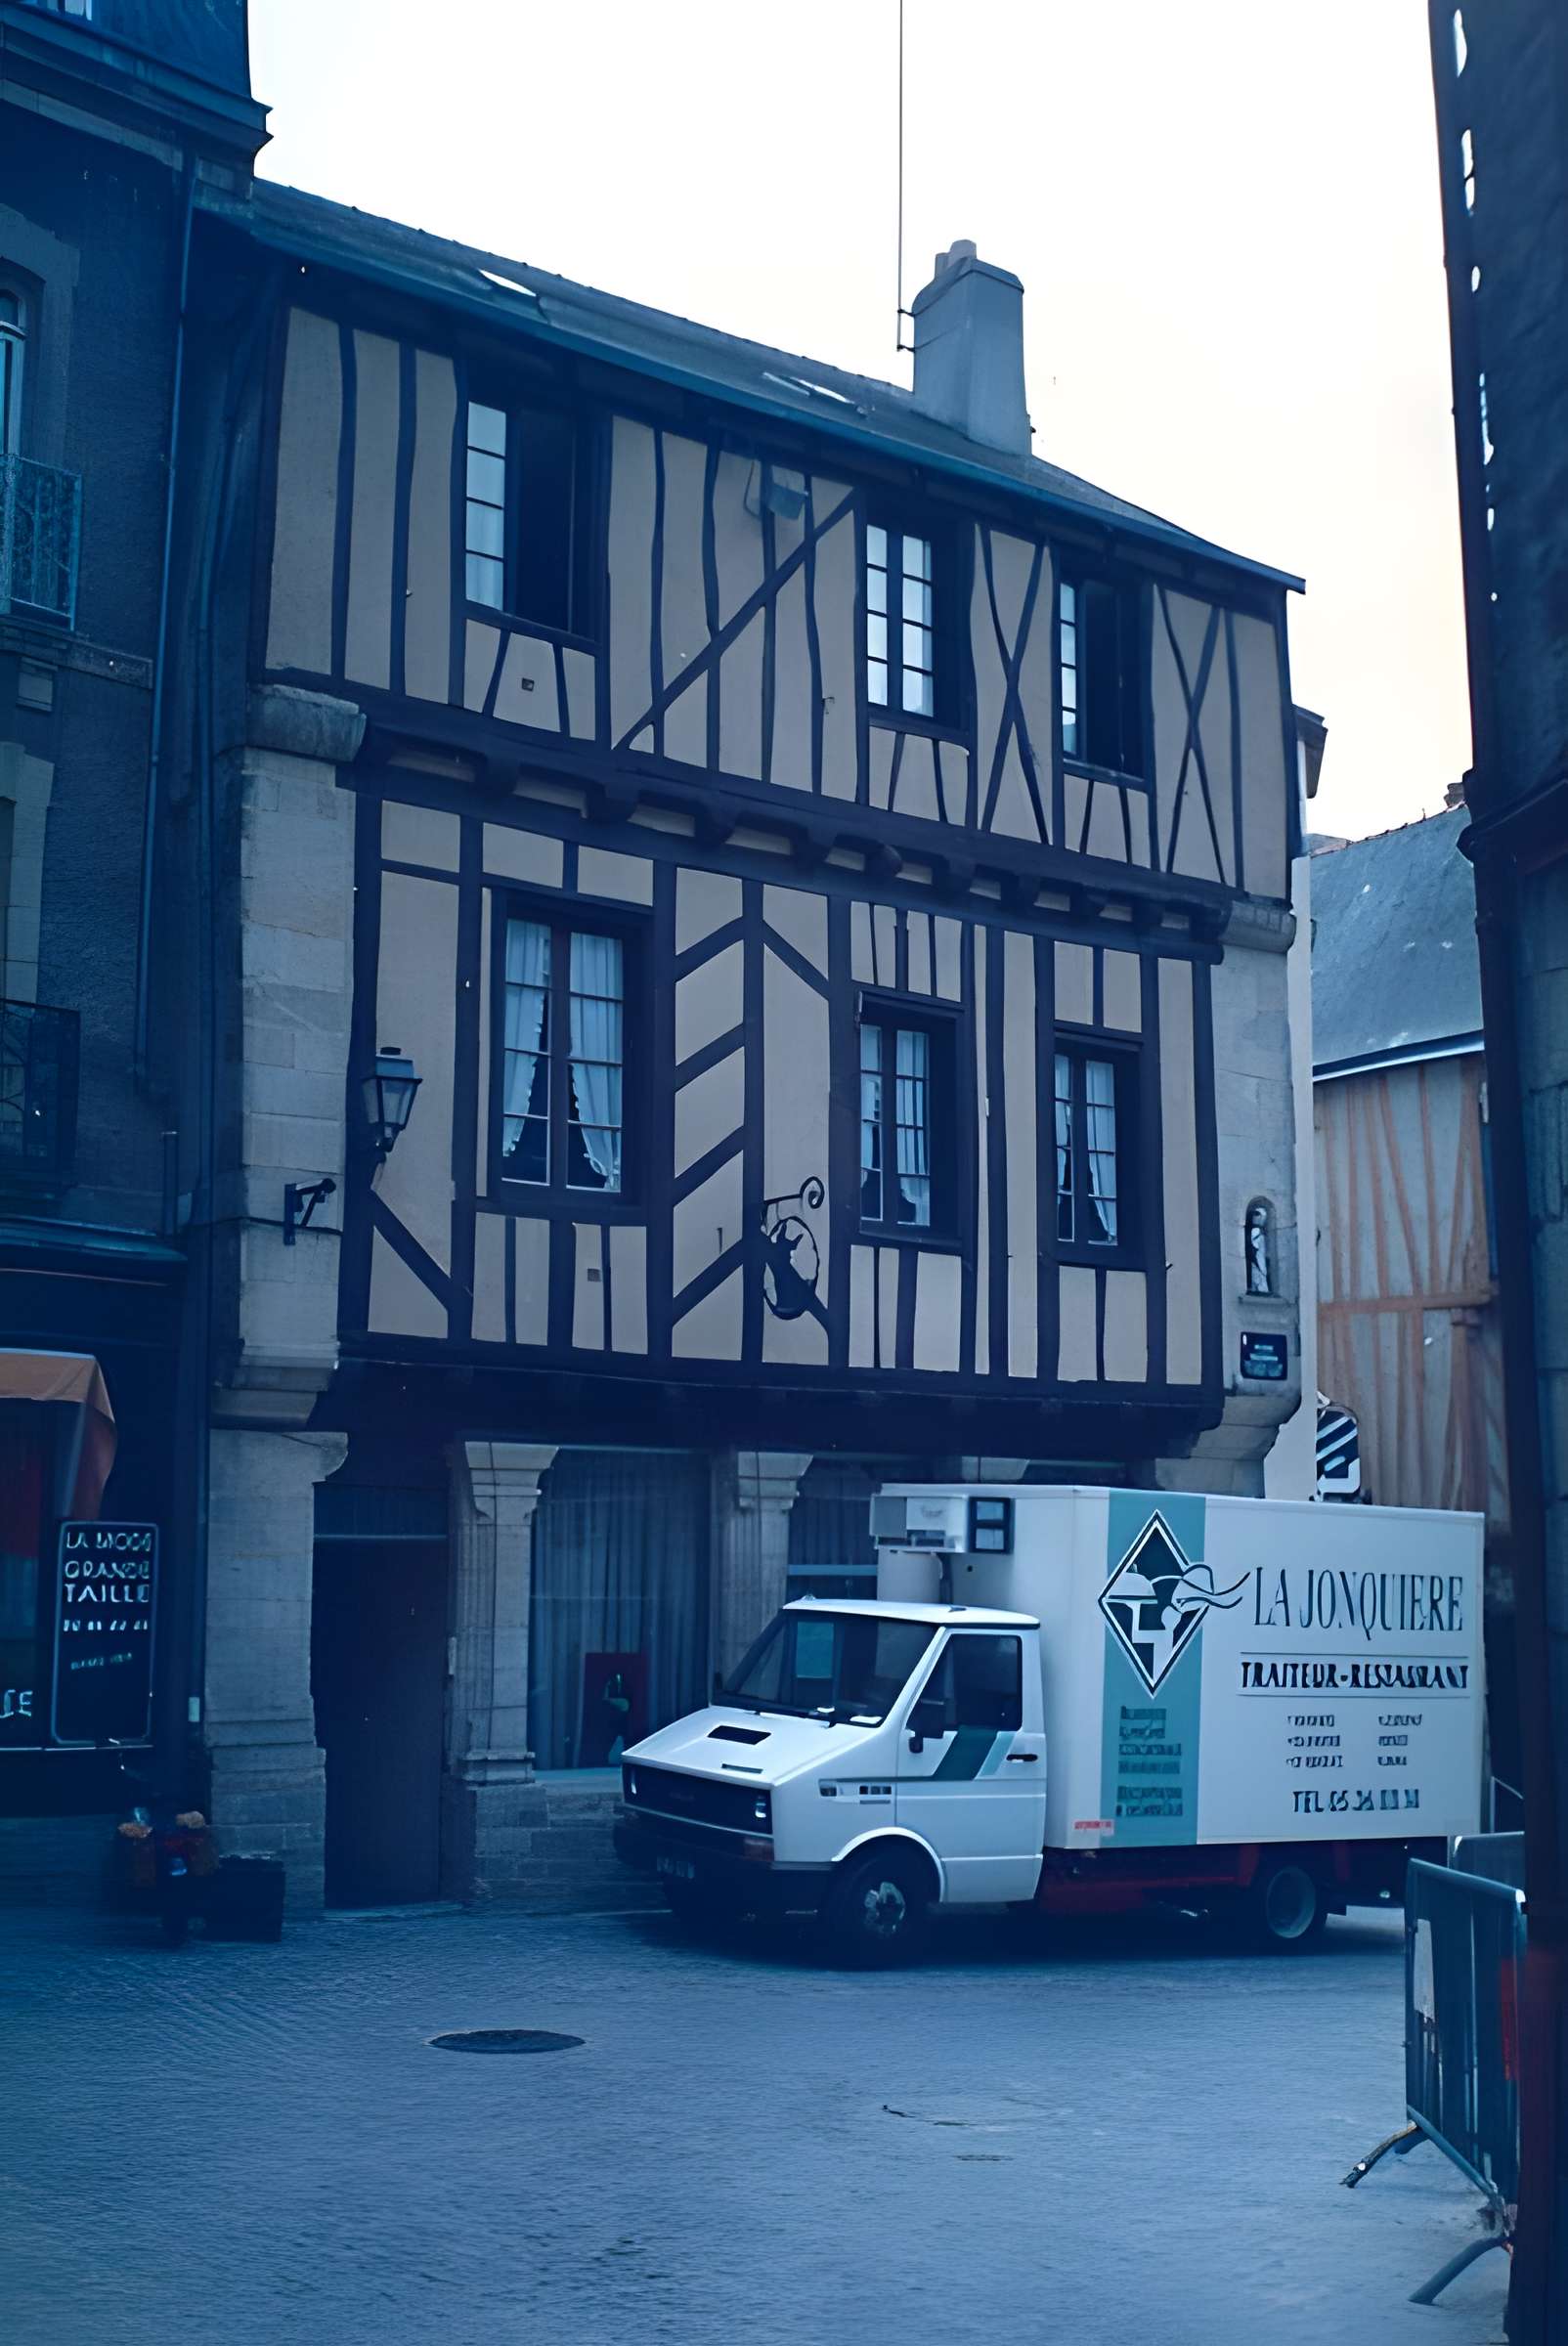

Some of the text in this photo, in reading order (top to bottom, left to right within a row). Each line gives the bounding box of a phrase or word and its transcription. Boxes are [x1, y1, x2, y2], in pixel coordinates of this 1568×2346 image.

[65, 1584, 150, 1603] TAILLE
[1254, 1567, 1463, 1640] LA JONQUIERE
